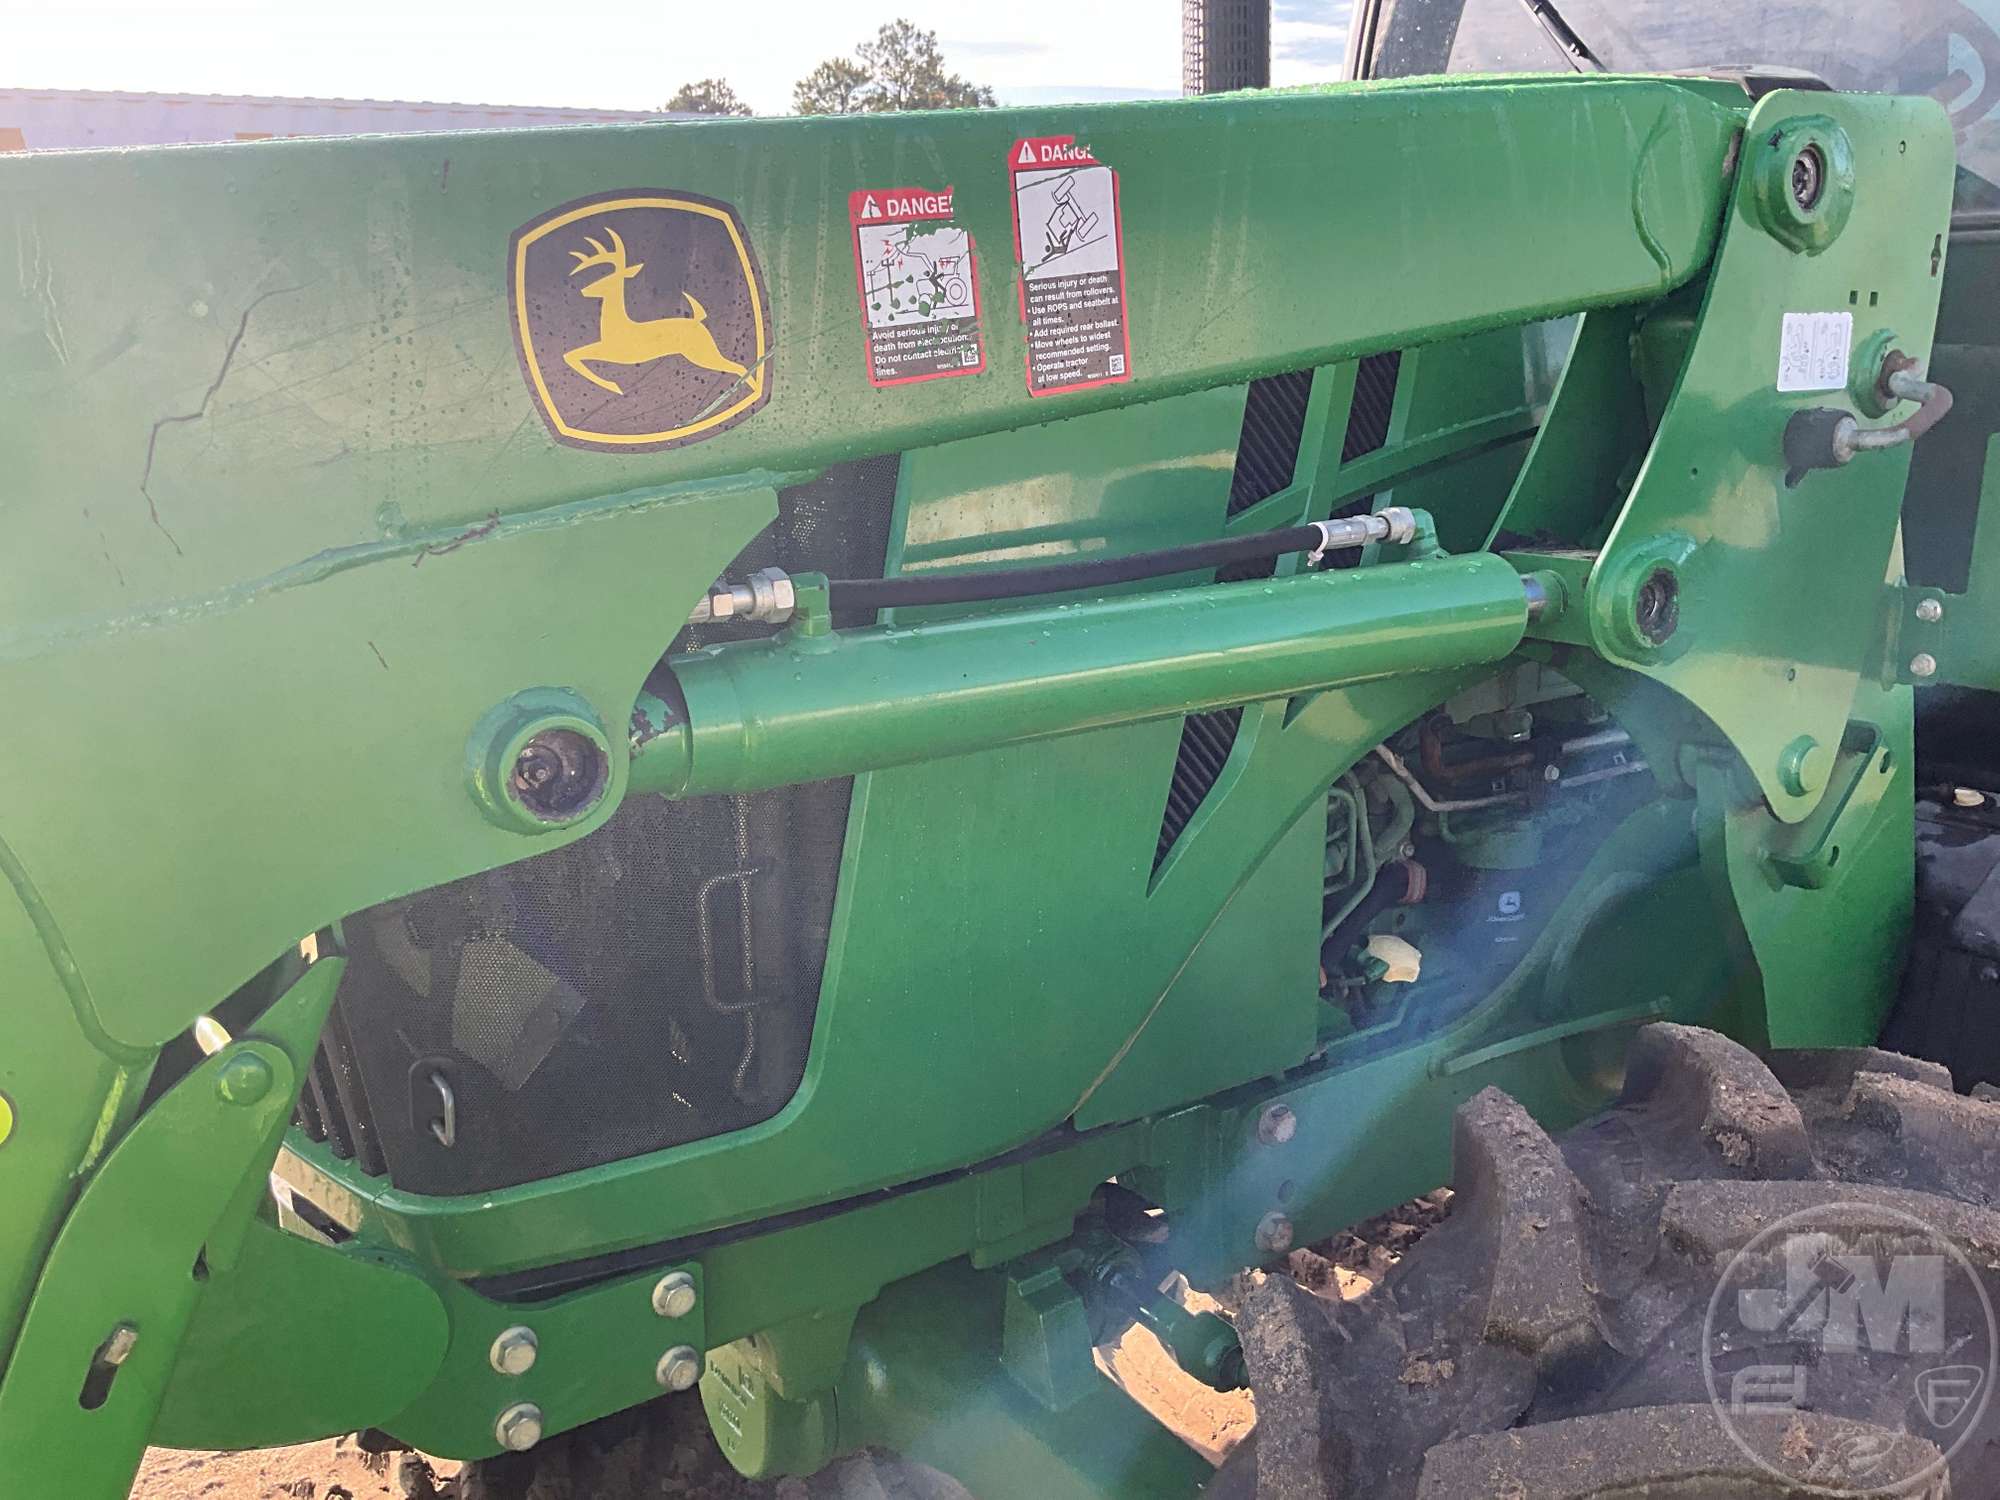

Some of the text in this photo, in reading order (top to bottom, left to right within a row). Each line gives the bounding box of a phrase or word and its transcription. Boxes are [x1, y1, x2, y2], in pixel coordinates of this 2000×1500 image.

[1029, 282, 1056, 291] Serious
[1057, 279, 1078, 289] injury
[1088, 275, 1108, 284] death
[1029, 295, 1043, 303] can
[1044, 292, 1065, 301] result
[1066, 289, 1082, 299] from
[1031, 296, 1119, 315] Use ROPS and seatbelt at
[1032, 316, 1064, 326] all times.
[1034, 318, 1120, 337] Add required rear ballast.
[872, 330, 895, 340] Avoid
[896, 327, 926, 337] serious
[927, 324, 949, 334] injuy
[873, 342, 896, 352] death
[897, 340, 916, 350] from
[1034, 340, 1054, 349] Move
[1055, 336, 1079, 346] wheels
[1089, 331, 1112, 341] widest
[874, 355, 886, 364] Do
[888, 354, 902, 363] not
[903, 350, 932, 361] contact
[1035, 343, 1112, 360] recommended setting.
[1037, 357, 1088, 372] Operate tractor
[876, 368, 898, 377] lines.
[1037, 375, 1045, 383] at
[1046, 373, 1058, 382] low
[1059, 369, 1082, 380] speed.
